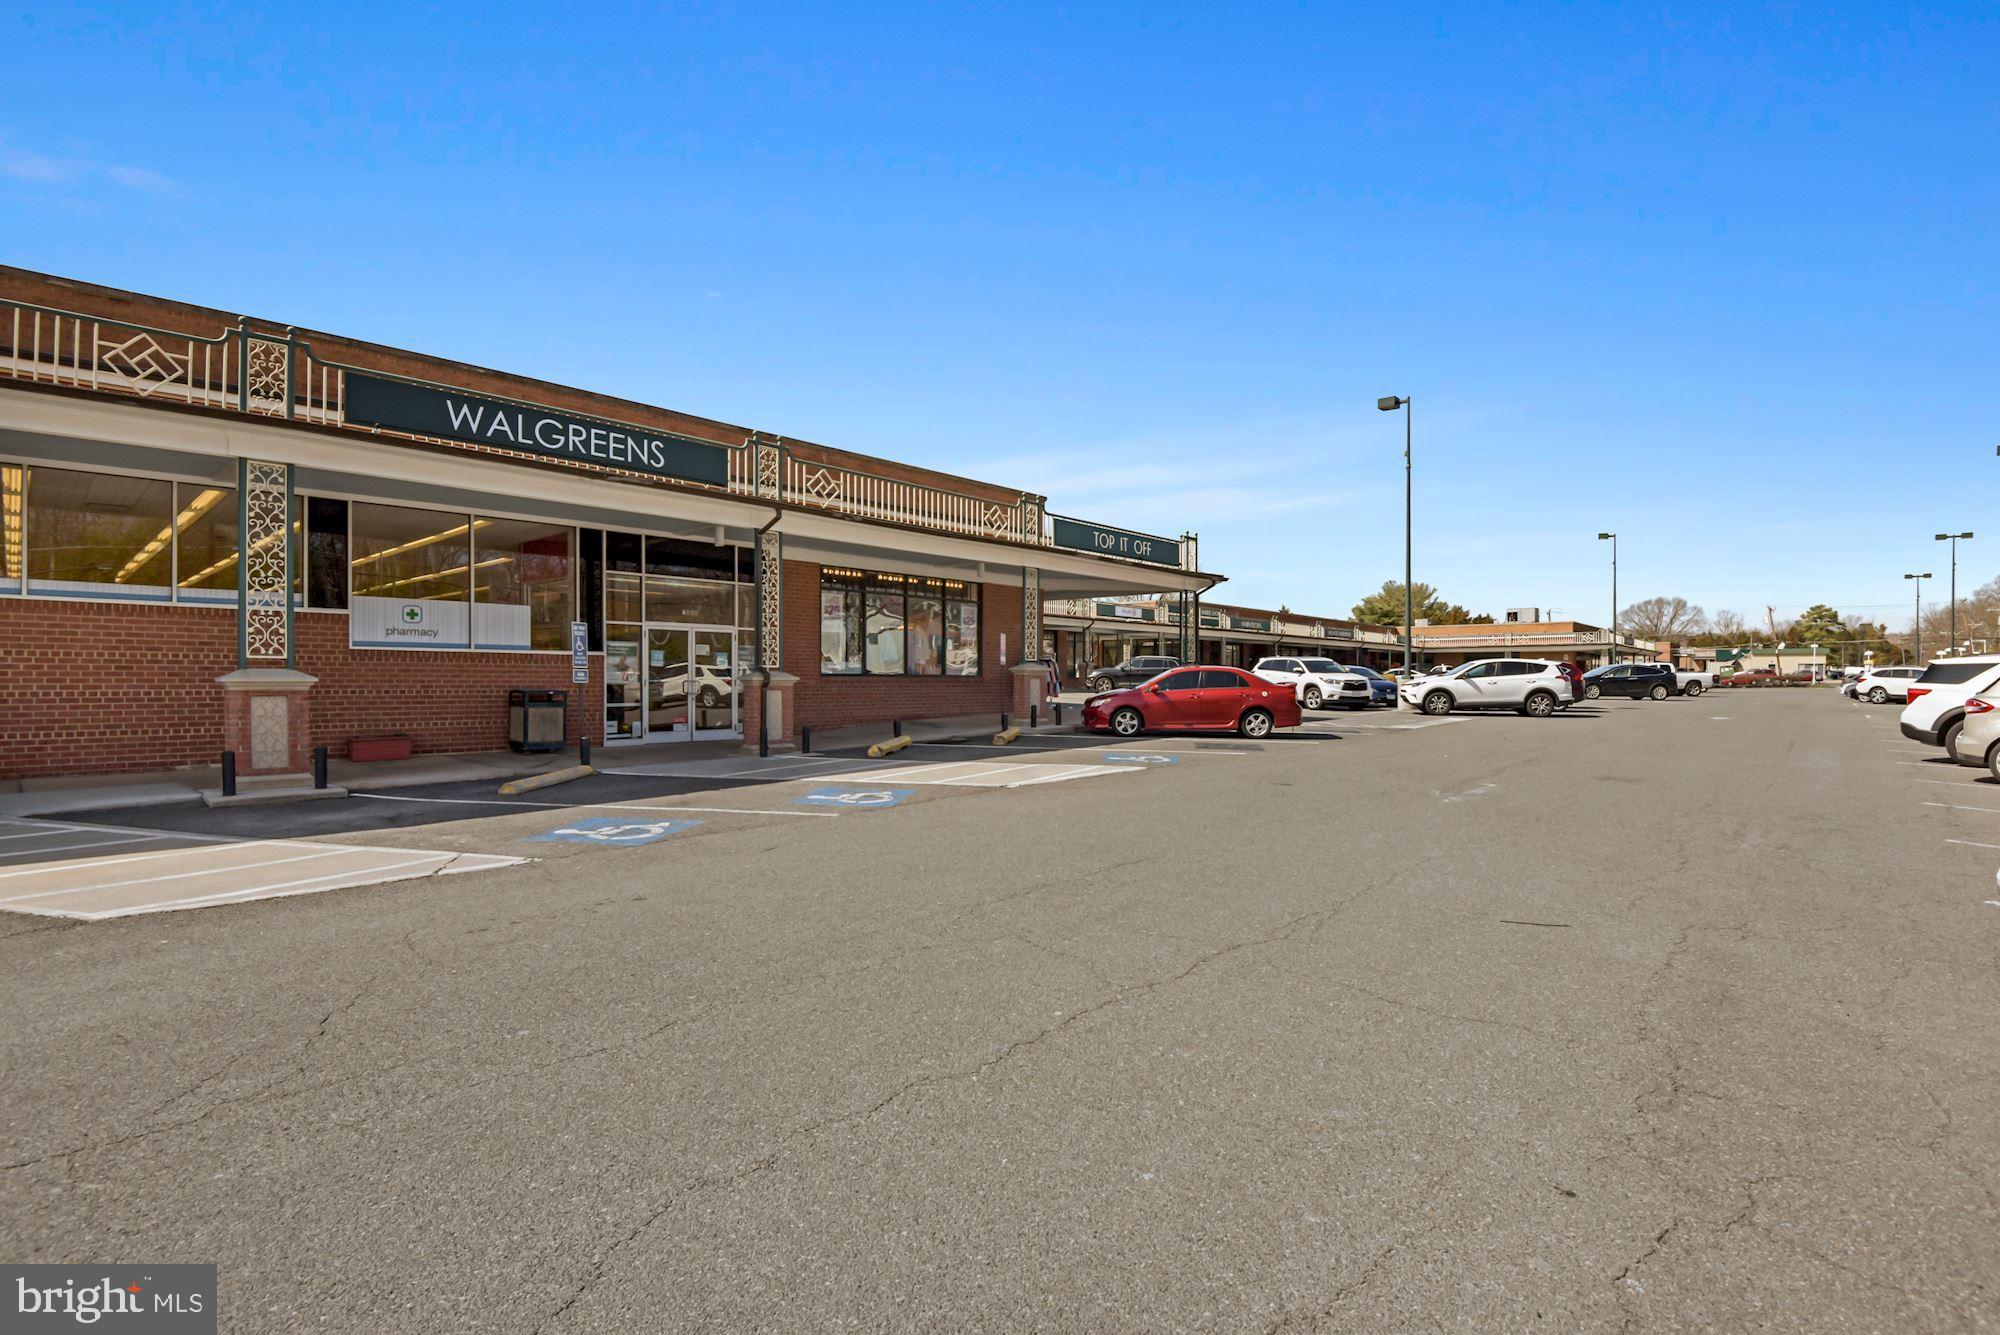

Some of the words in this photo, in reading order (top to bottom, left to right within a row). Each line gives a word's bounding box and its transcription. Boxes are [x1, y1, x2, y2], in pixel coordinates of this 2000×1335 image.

[446, 399, 665, 469] WALGREENS
[1093, 531, 1115, 550] TOP
[1120, 536, 1129, 552] IT
[1133, 540, 1152, 556] OFF
[385, 626, 439, 639] pharmacy
